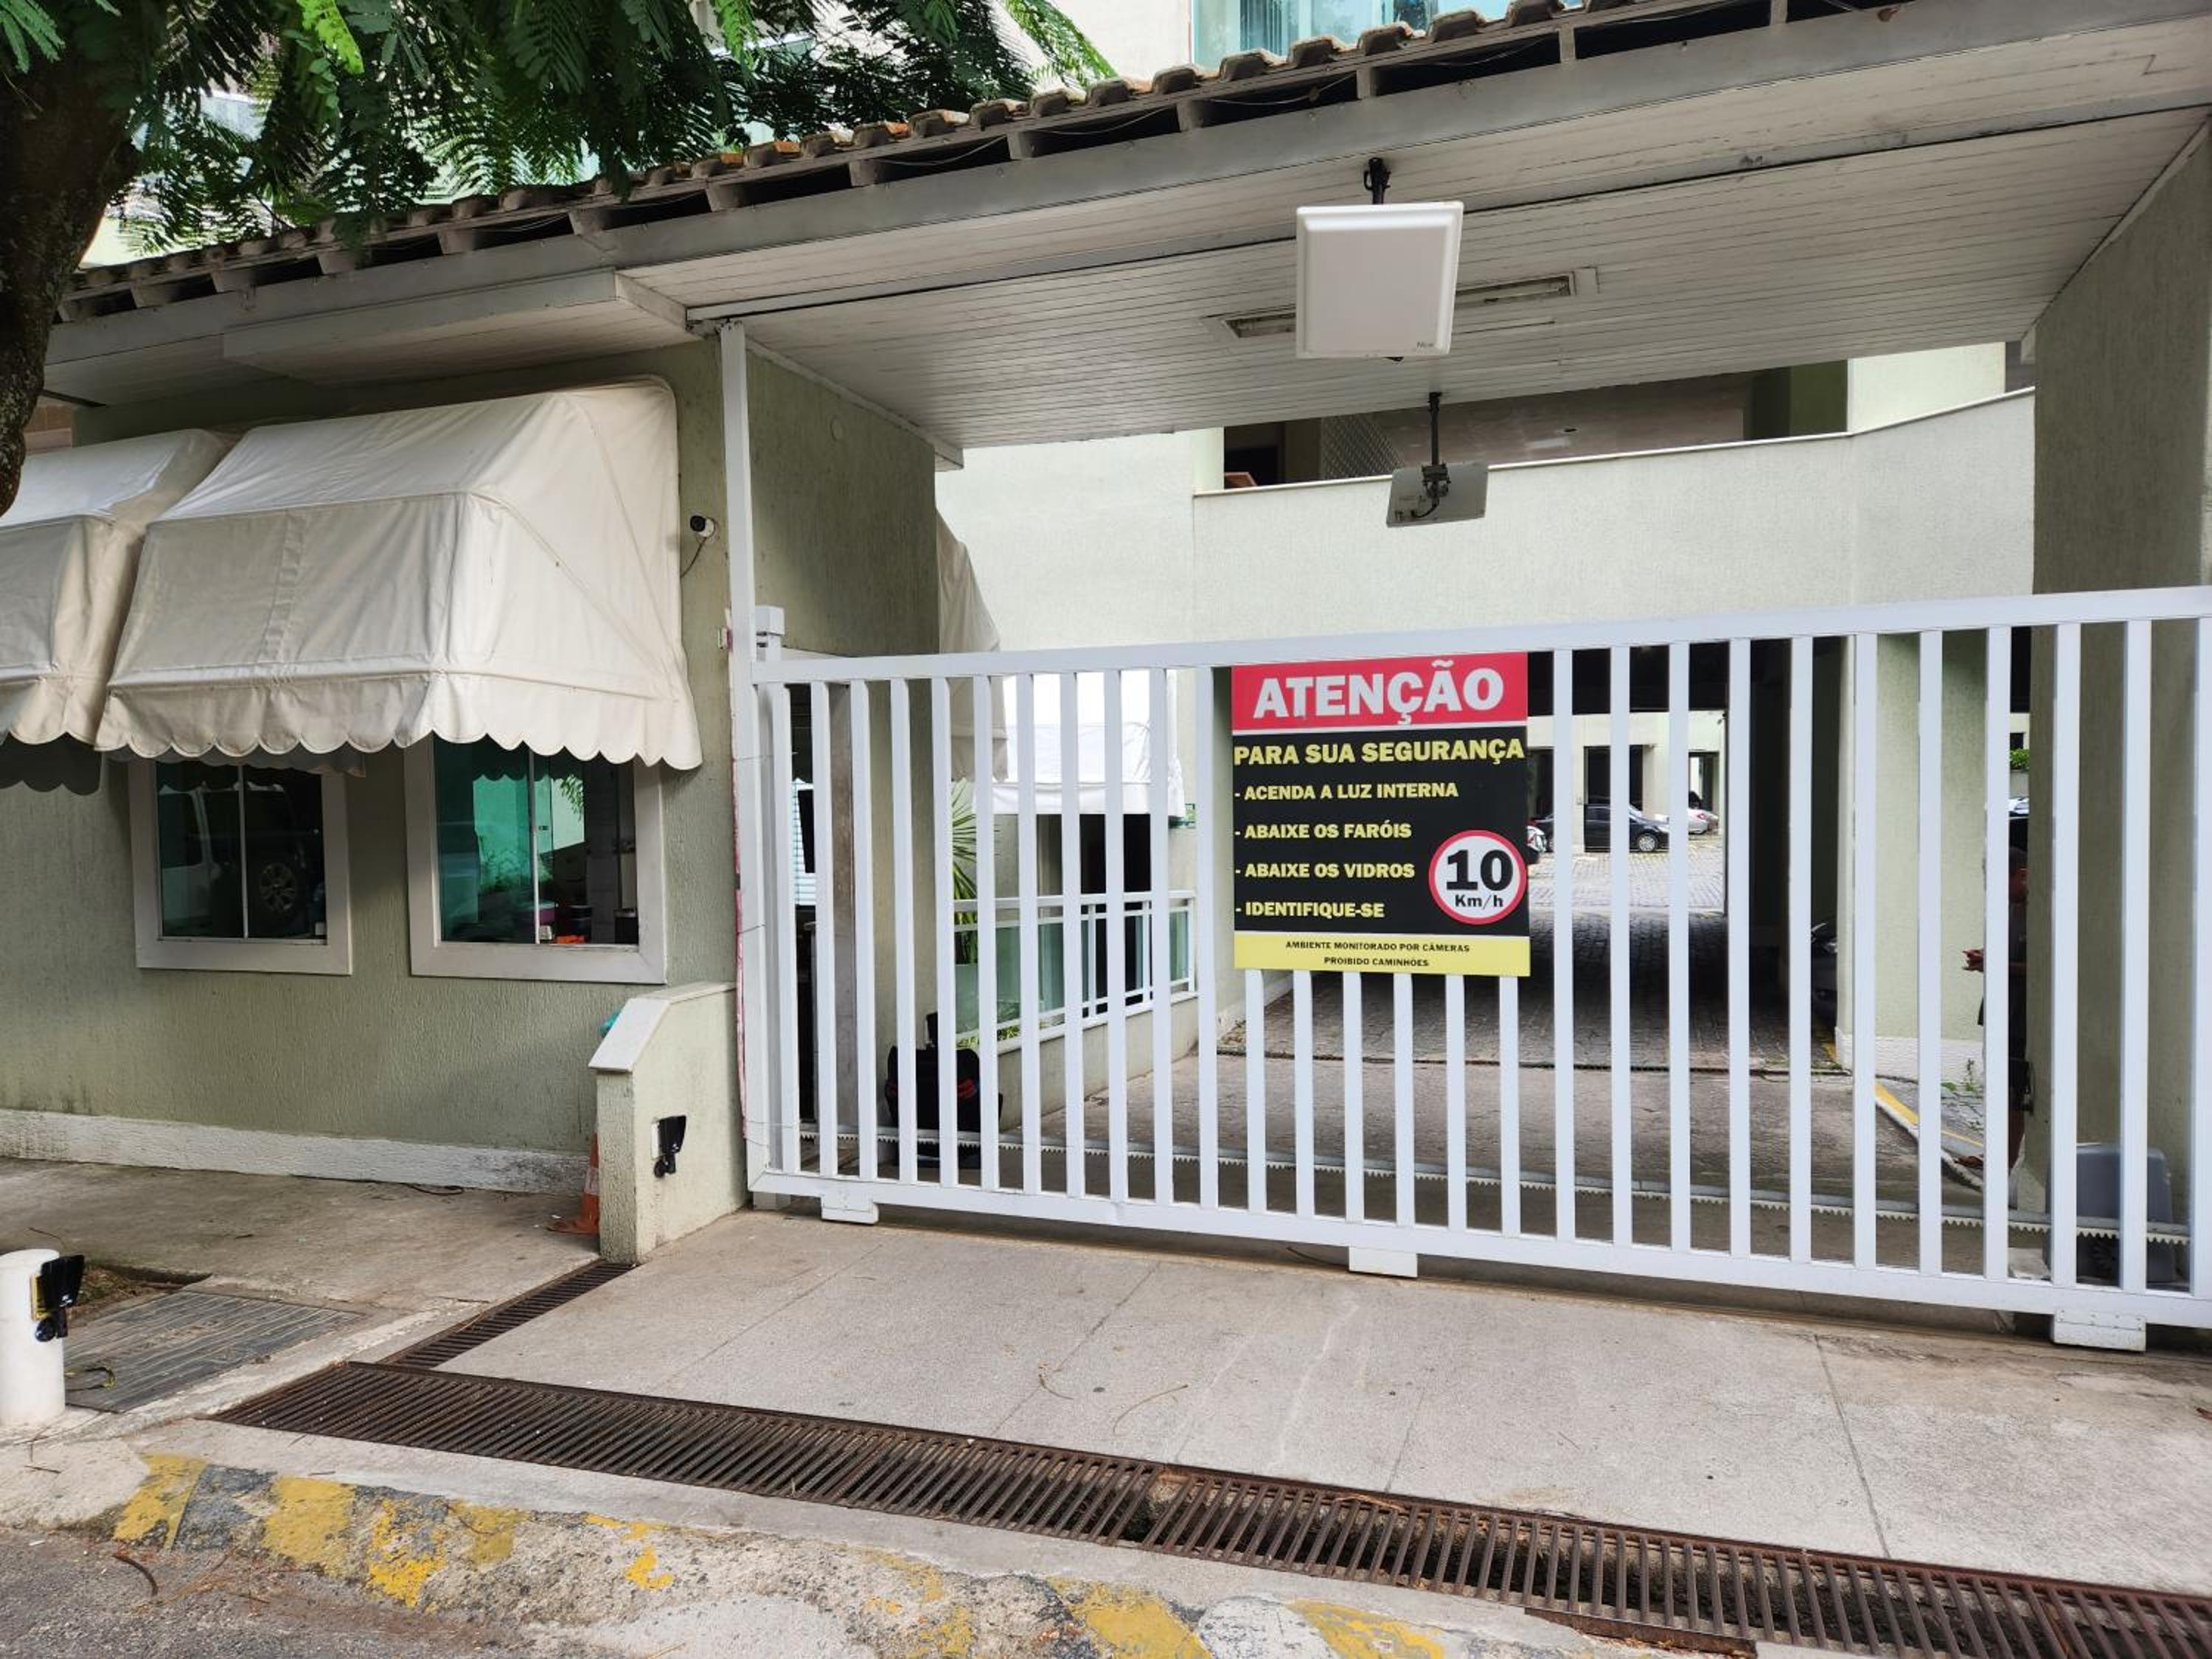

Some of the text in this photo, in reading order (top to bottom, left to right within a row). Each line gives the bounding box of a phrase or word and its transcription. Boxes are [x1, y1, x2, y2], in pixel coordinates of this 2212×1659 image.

[1253, 659, 1504, 725] ATENÇÃO
[1234, 738, 1525, 765] PARA SUA SEGURANÇA
[1244, 785, 1316, 800] ACENDA
[1321, 785, 1332, 799] A
[1338, 785, 1372, 799] LUZ
[1377, 782, 1459, 799] INTERNA
[1245, 824, 1310, 838] ABAIXE
[1314, 824, 1340, 838] OS
[1344, 820, 1413, 838] FARÓIS
[1245, 863, 1310, 878] ABAIXE
[1314, 863, 1340, 878] OS
[1343, 863, 1416, 878] VIDROS
[1446, 849, 1514, 891] 10
[1245, 902, 1385, 918] IDENTIFIQUE-SE
[1454, 894, 1505, 909] Km/h
[1285, 941, 1332, 950] AMBIENTE
[1334, 942, 1397, 951] MONITORADO
[1399, 943, 1419, 951] POR
[1324, 956, 1369, 965] PROIBIDO
